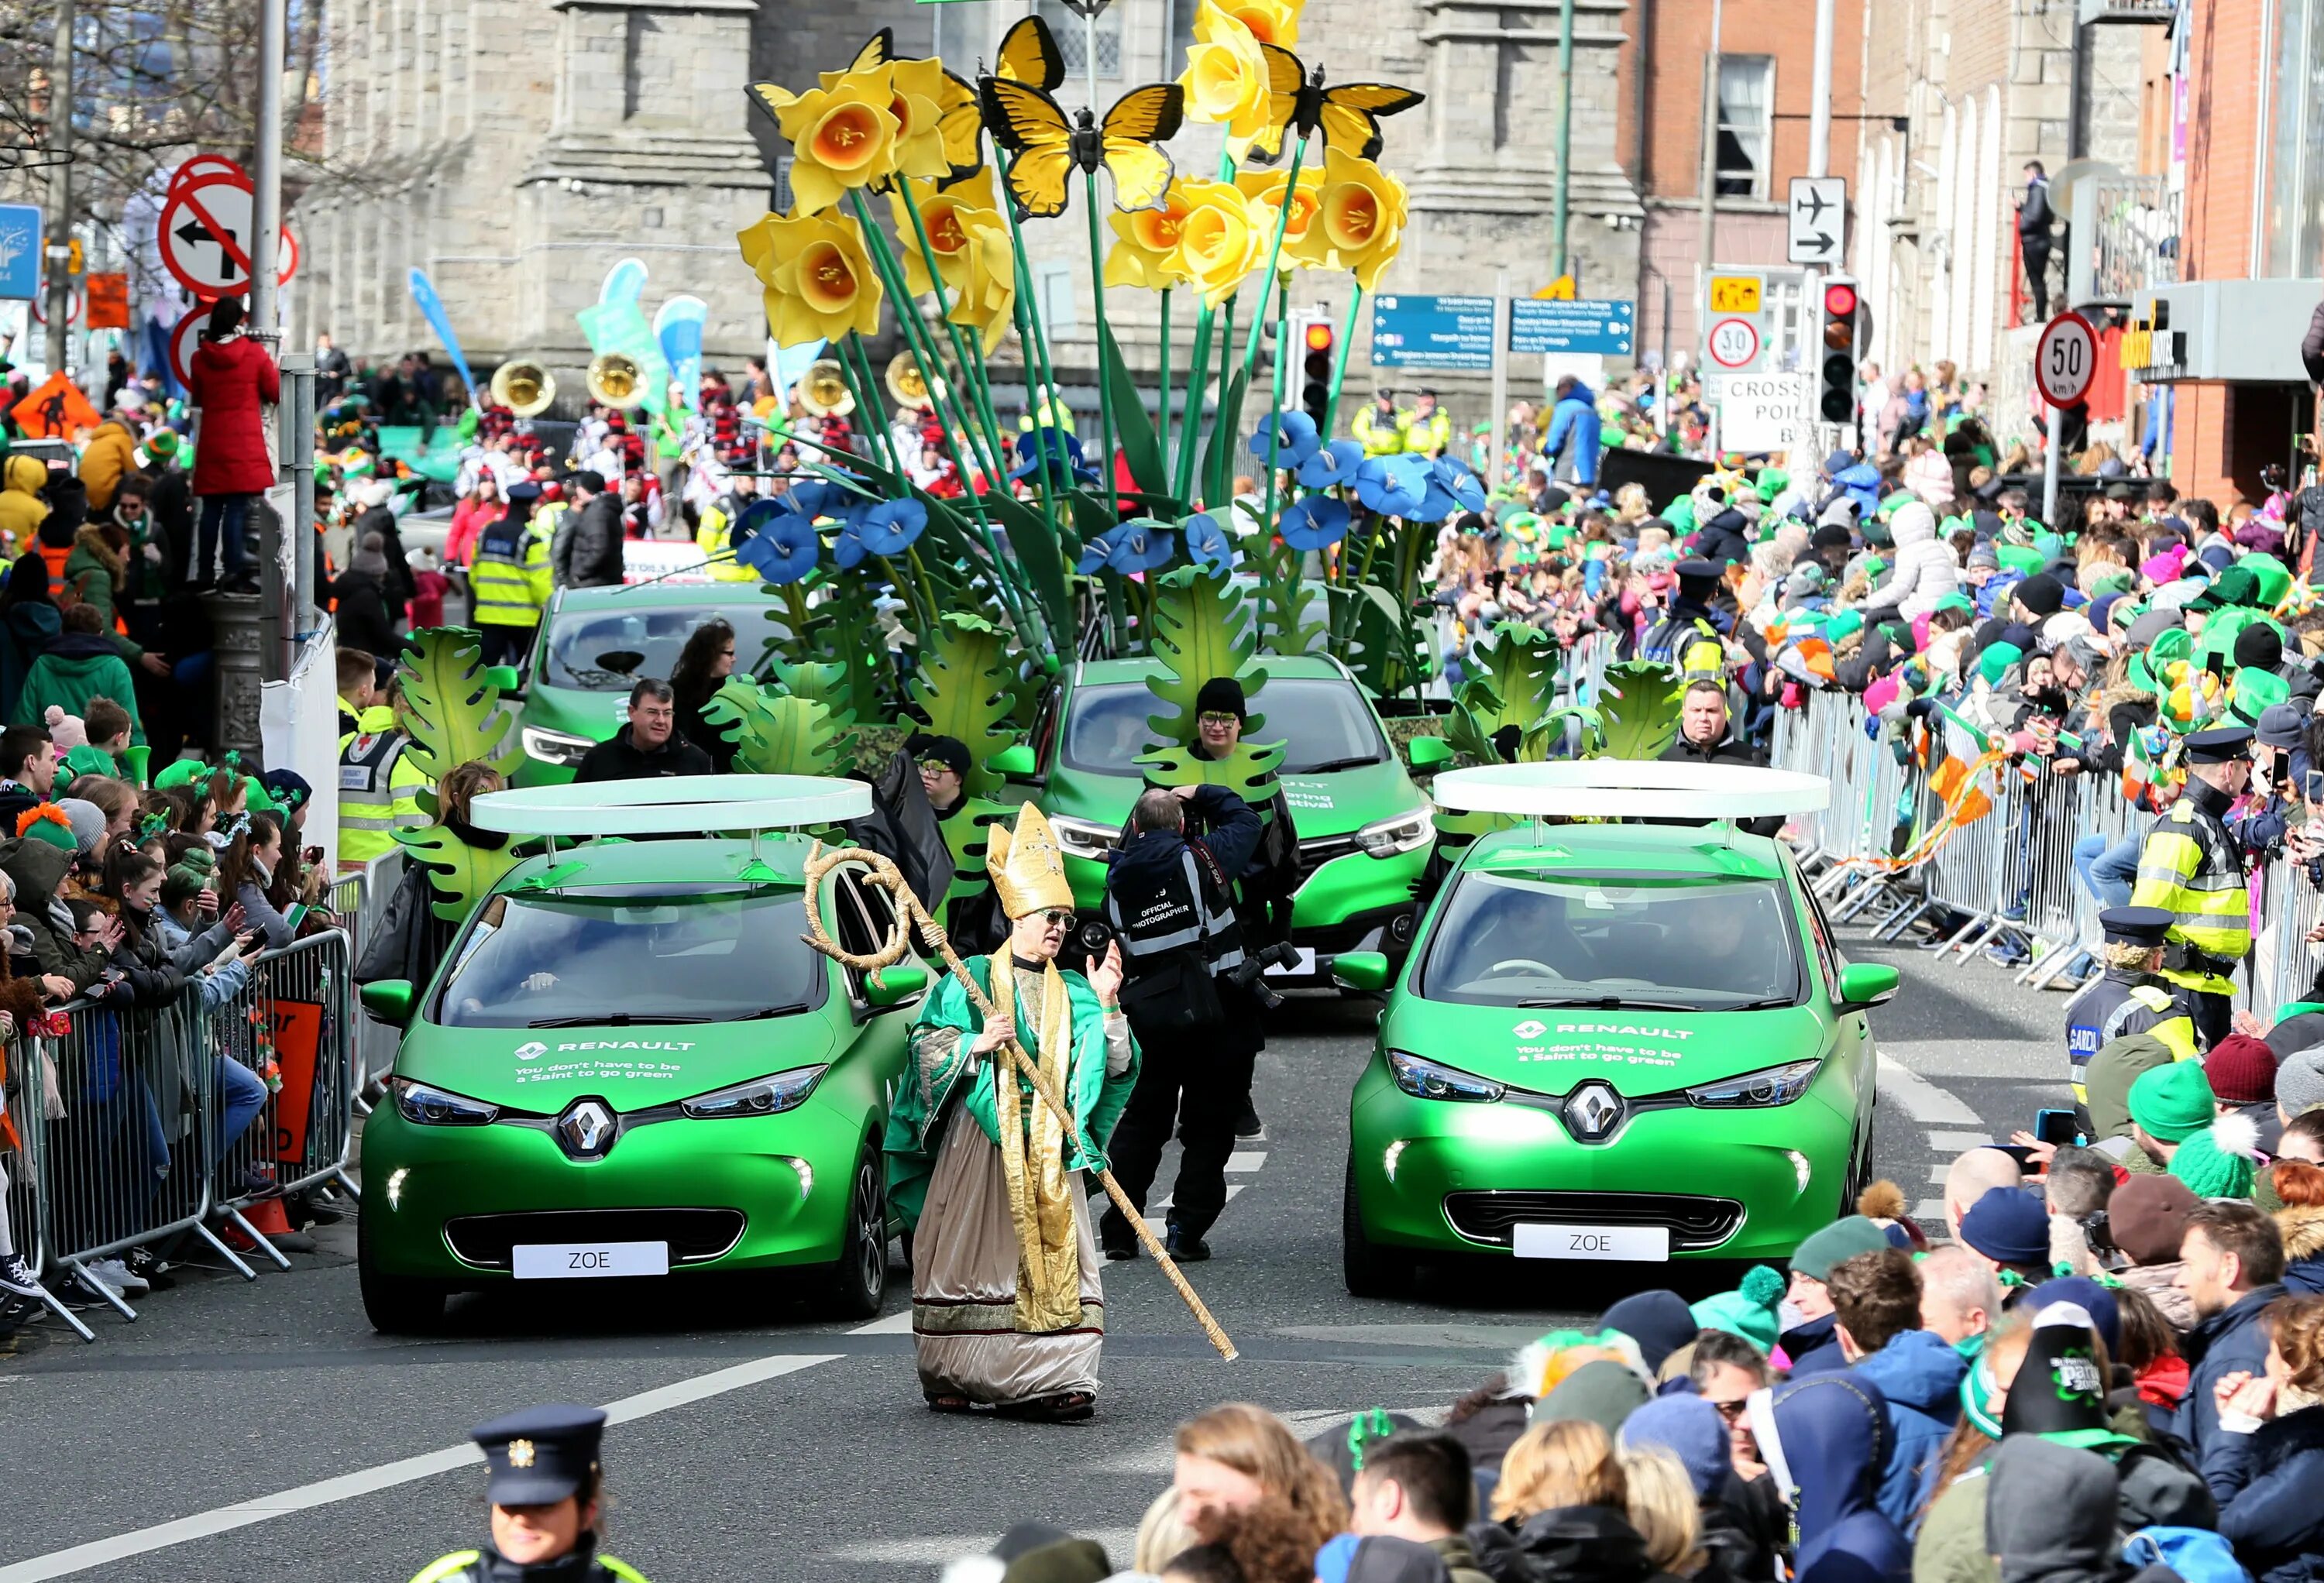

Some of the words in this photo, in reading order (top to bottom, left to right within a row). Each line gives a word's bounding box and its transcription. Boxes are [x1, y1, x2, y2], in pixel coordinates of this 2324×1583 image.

[1721, 330, 1746, 351] 30
[2151, 329, 2174, 367] HOTEL
[2052, 338, 2082, 376] 50
[1731, 382, 1801, 397] CROSS
[2053, 383, 2077, 395] km/h
[1755, 404, 1800, 421] POI
[1287, 799, 1334, 809] stival
[1212, 868, 1222, 884] EOS
[1140, 901, 1174, 918] OFFICIAL
[1556, 1024, 1694, 1040] RENAULT
[2069, 1028, 2098, 1052] GARDA
[557, 1041, 696, 1052] RENAULT
[1515, 1046, 1545, 1055] You
[1549, 1043, 1591, 1053] don't
[1595, 1043, 1635, 1054] have
[1639, 1047, 1657, 1056] to
[1661, 1049, 1682, 1059] be
[1533, 1052, 1576, 1062] Saint
[1580, 1052, 1598, 1060] to
[1602, 1053, 1624, 1062] go
[1627, 1055, 1676, 1066] green
[514, 1066, 543, 1076] You
[548, 1061, 590, 1073] don't
[594, 1060, 633, 1069] have
[638, 1061, 655, 1070] to
[659, 1063, 681, 1071] be
[531, 1070, 573, 1082] Saint
[578, 1069, 595, 1077] to
[600, 1070, 621, 1079] go
[625, 1070, 673, 1080] green
[1569, 1234, 1611, 1252] ZOE
[568, 1252, 610, 1269] ZOE
